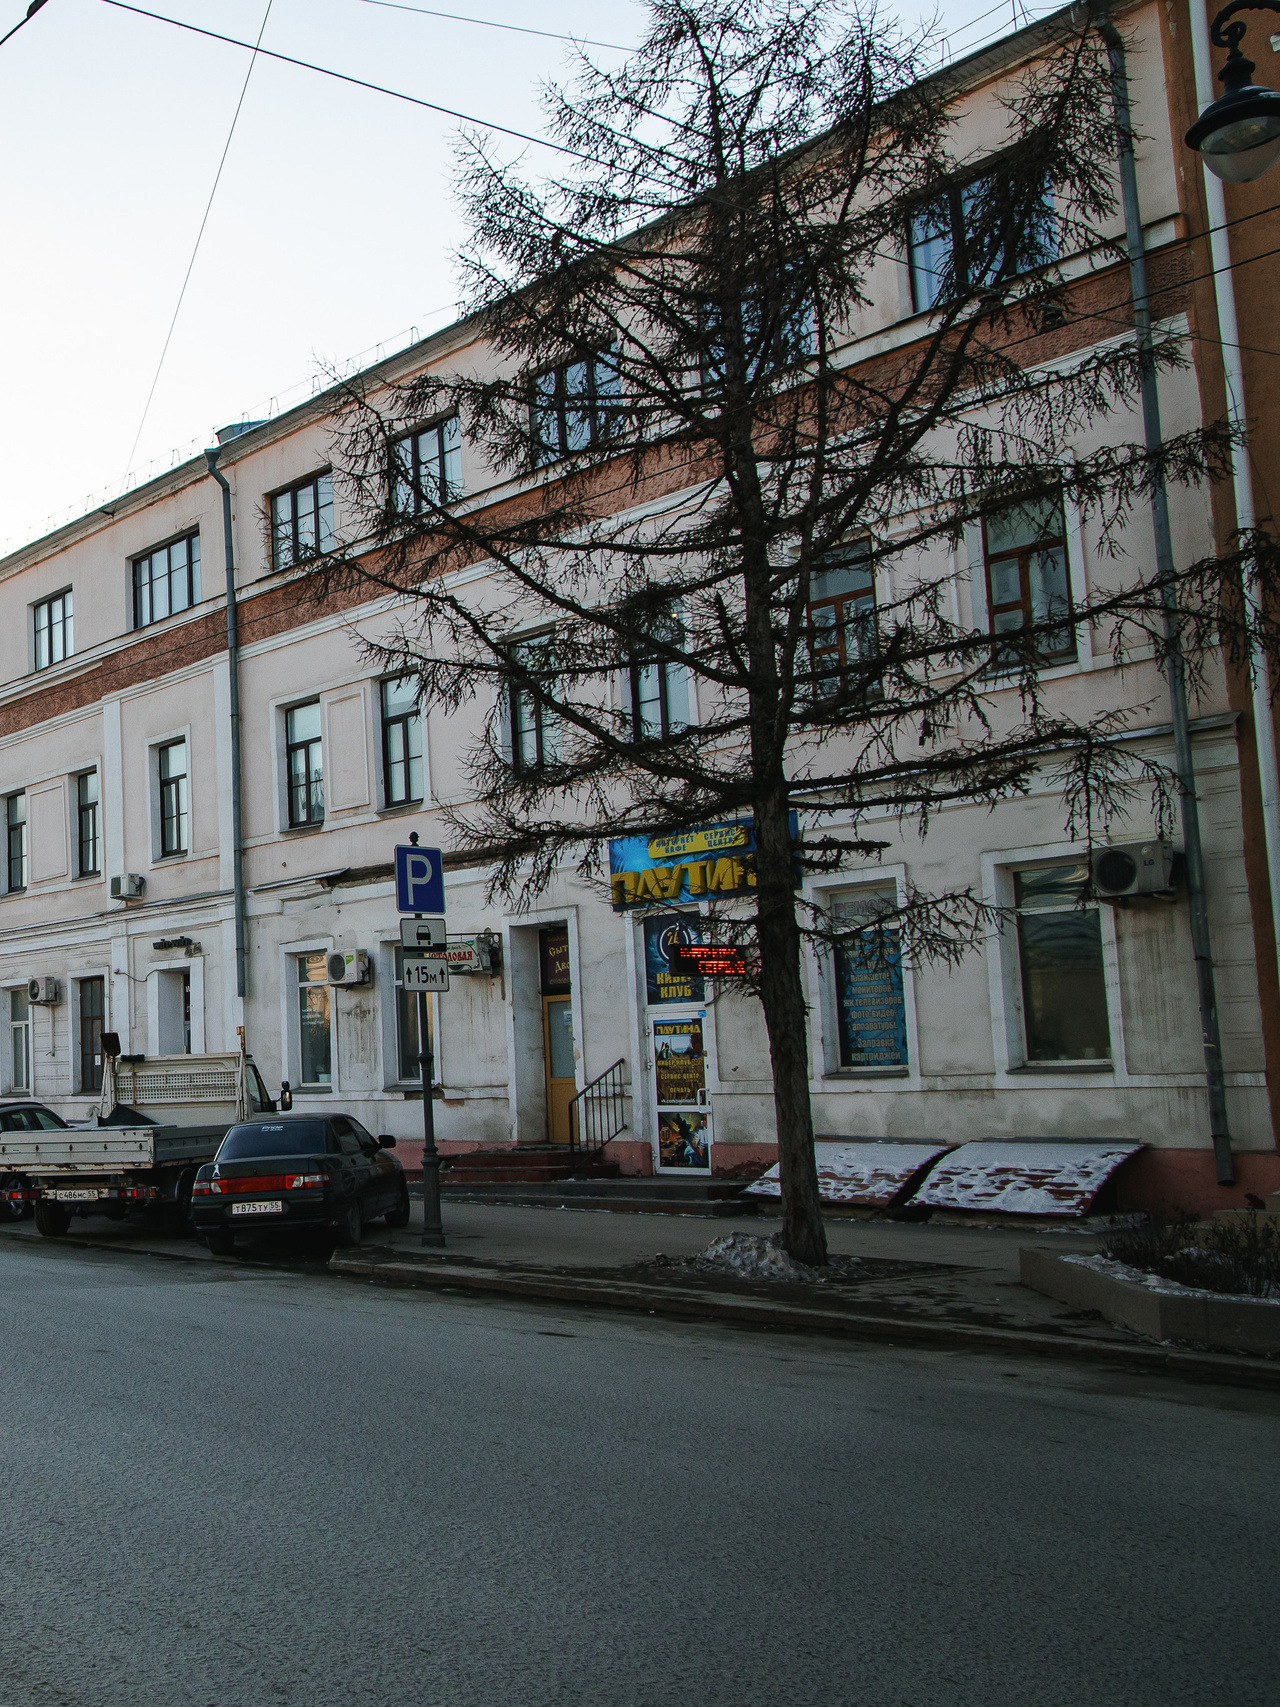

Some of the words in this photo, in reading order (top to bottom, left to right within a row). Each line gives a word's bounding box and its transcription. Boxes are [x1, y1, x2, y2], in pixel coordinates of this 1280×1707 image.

[704, 828, 736, 841] СЕРВИС
[655, 835, 695, 848] ИНТЕРНЕТ
[665, 844, 686, 854] КАФЕ
[406, 854, 433, 906] P
[611, 853, 758, 905] ПАУТИН
[660, 985, 692, 999] КЛУБ
[656, 1024, 701, 1035] ПАУТИНА
[857, 1038, 895, 1049] Заправка
